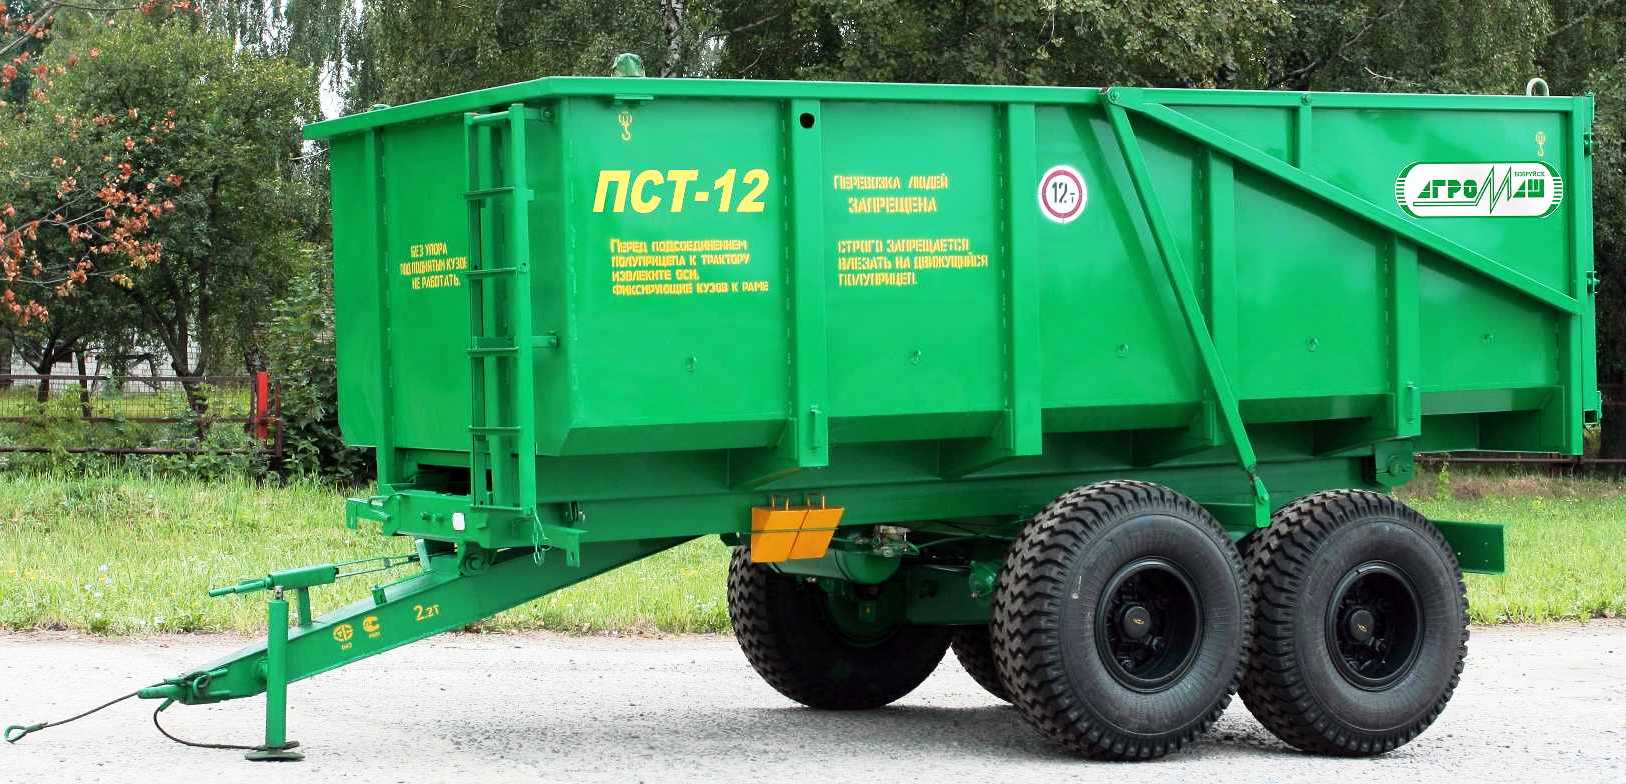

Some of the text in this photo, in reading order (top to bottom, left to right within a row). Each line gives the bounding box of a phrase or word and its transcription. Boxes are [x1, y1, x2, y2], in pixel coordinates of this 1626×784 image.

[833, 172, 949, 190] ПЕРЕВОЗКА ЛЮДЕЙ
[592, 168, 770, 214] ПСТ-12
[848, 196, 938, 214] ЗАПРЕЩЕНА
[425, 241, 448, 256] УПОРА
[651, 239, 749, 252] ПОДСОЕДИНЕНИЕМ
[837, 237, 970, 253] СТРОГО ЗАПРЕЩАЕТСЯ
[611, 253, 751, 268] ПОЛУПРИЦЕПА К ТРАКТОРУ
[837, 252, 989, 270] ВЛЕЗАТЬ НА ДВИЖУЩИЙСЯ
[611, 270, 672, 283] ИЗВЛЕКИТЕ
[612, 280, 769, 297] ФИКСИРУЮЩИЕ КУЗОВ К РАМЕ
